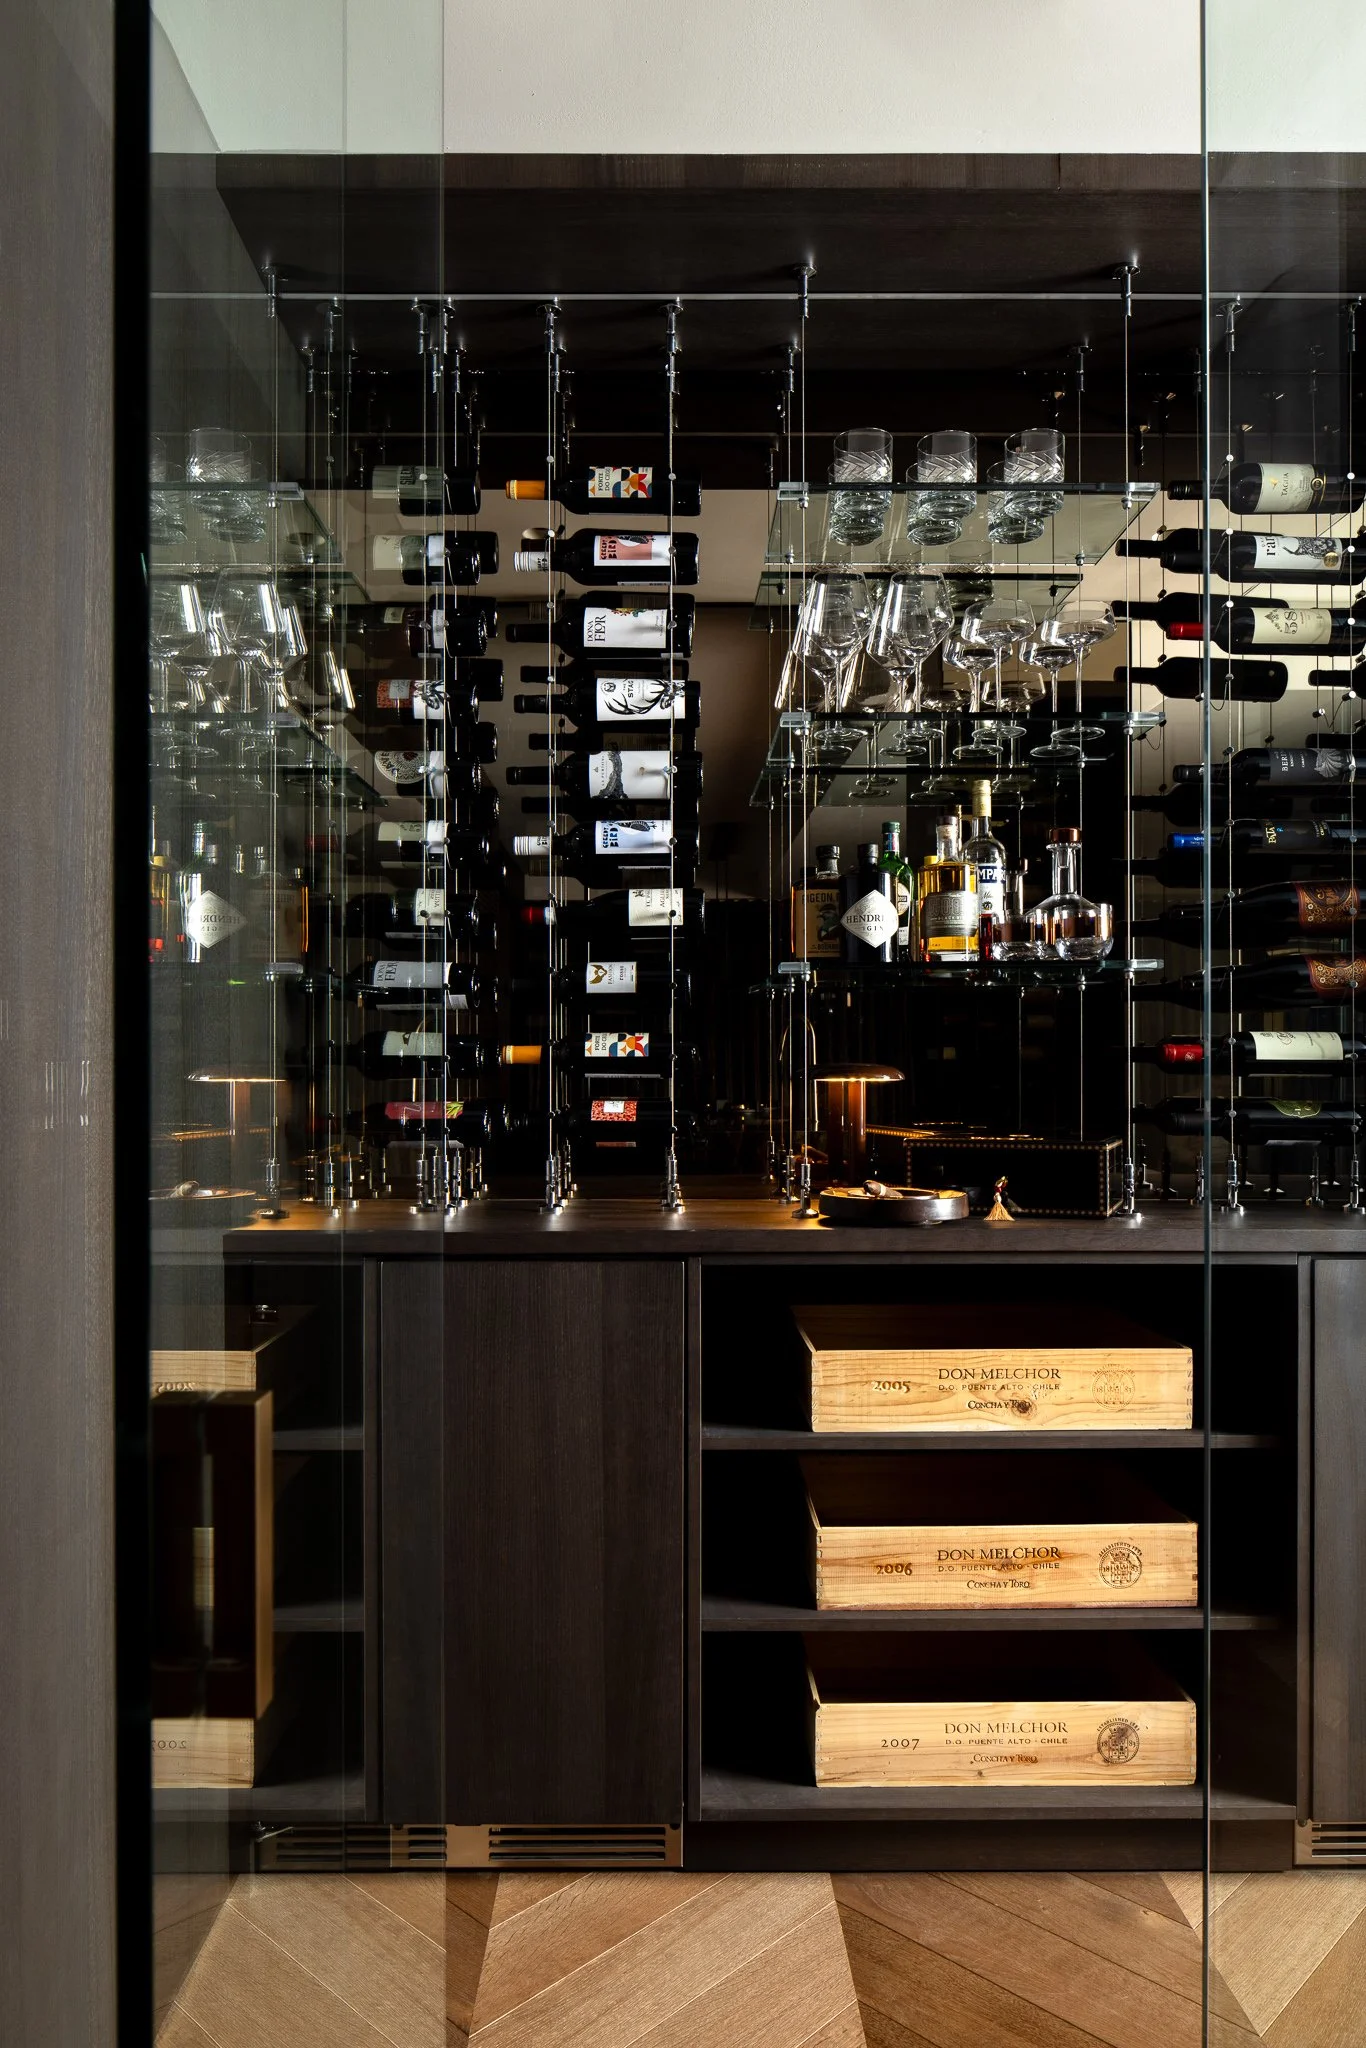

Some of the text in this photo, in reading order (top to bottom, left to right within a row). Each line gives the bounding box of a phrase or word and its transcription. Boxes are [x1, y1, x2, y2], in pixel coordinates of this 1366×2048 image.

[938, 1368, 1061, 1380] DON MELCHOR
[872, 1380, 911, 1393] 2005
[937, 1546, 1061, 1561] DON MELCHOR
[876, 1562, 913, 1576] 2006
[961, 1564, 997, 1572] PUENTE
[999, 1563, 1023, 1571] ALTO
[945, 1721, 1069, 1734] DON MELCHOR
[881, 1738, 920, 1751] 2007
